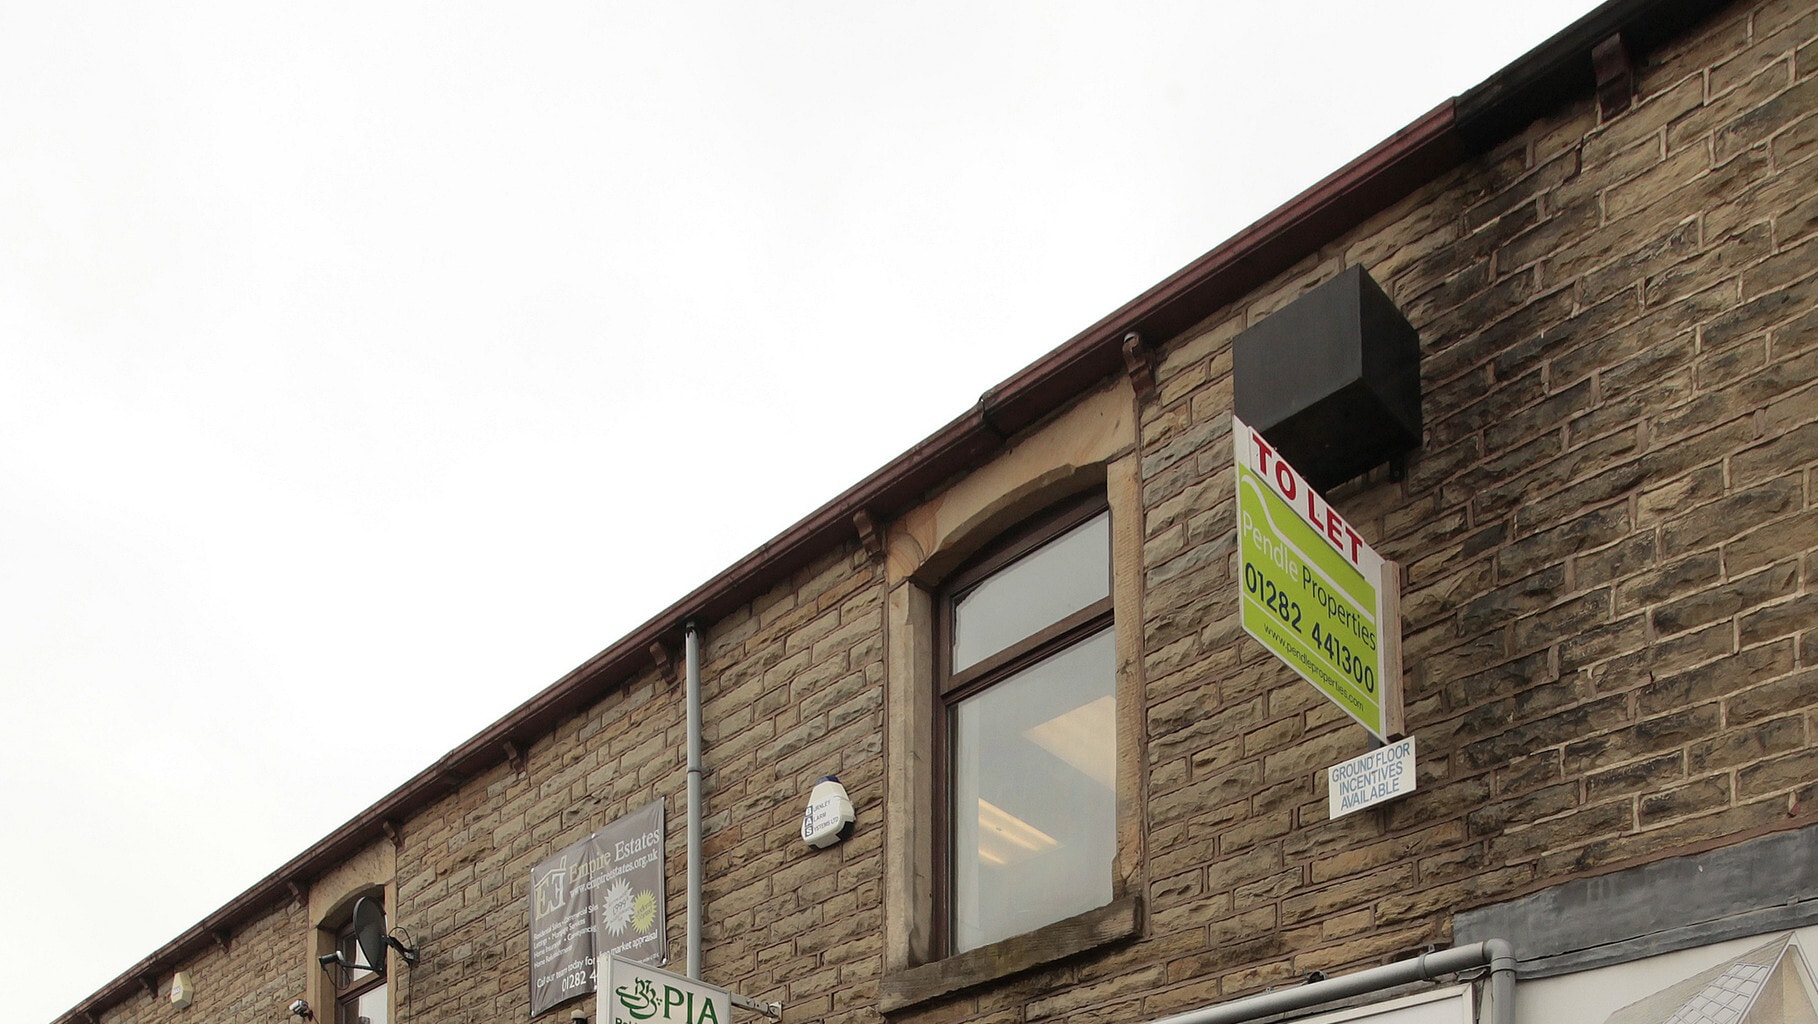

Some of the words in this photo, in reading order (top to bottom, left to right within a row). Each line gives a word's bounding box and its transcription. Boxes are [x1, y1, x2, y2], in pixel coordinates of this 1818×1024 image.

[1252, 434, 1297, 502] TO
[1308, 489, 1363, 566] LET
[1242, 510, 1299, 583] Pendle
[1302, 564, 1377, 652] Properties
[1245, 561, 1303, 634] 01282
[1311, 621, 1375, 694] 441300
[1263, 622, 1364, 712] www.pendleproperties.com
[1331, 754, 1374, 783] GROUND
[1374, 742, 1411, 765] FLOOR
[1339, 761, 1404, 796] INCENTIVES
[1340, 777, 1400, 812] AVAILABLE
[568, 850, 611, 885] Empire
[614, 829, 661, 862] Estates
[632, 928, 658, 949] appraisal
[561, 970, 587, 992] 01282
